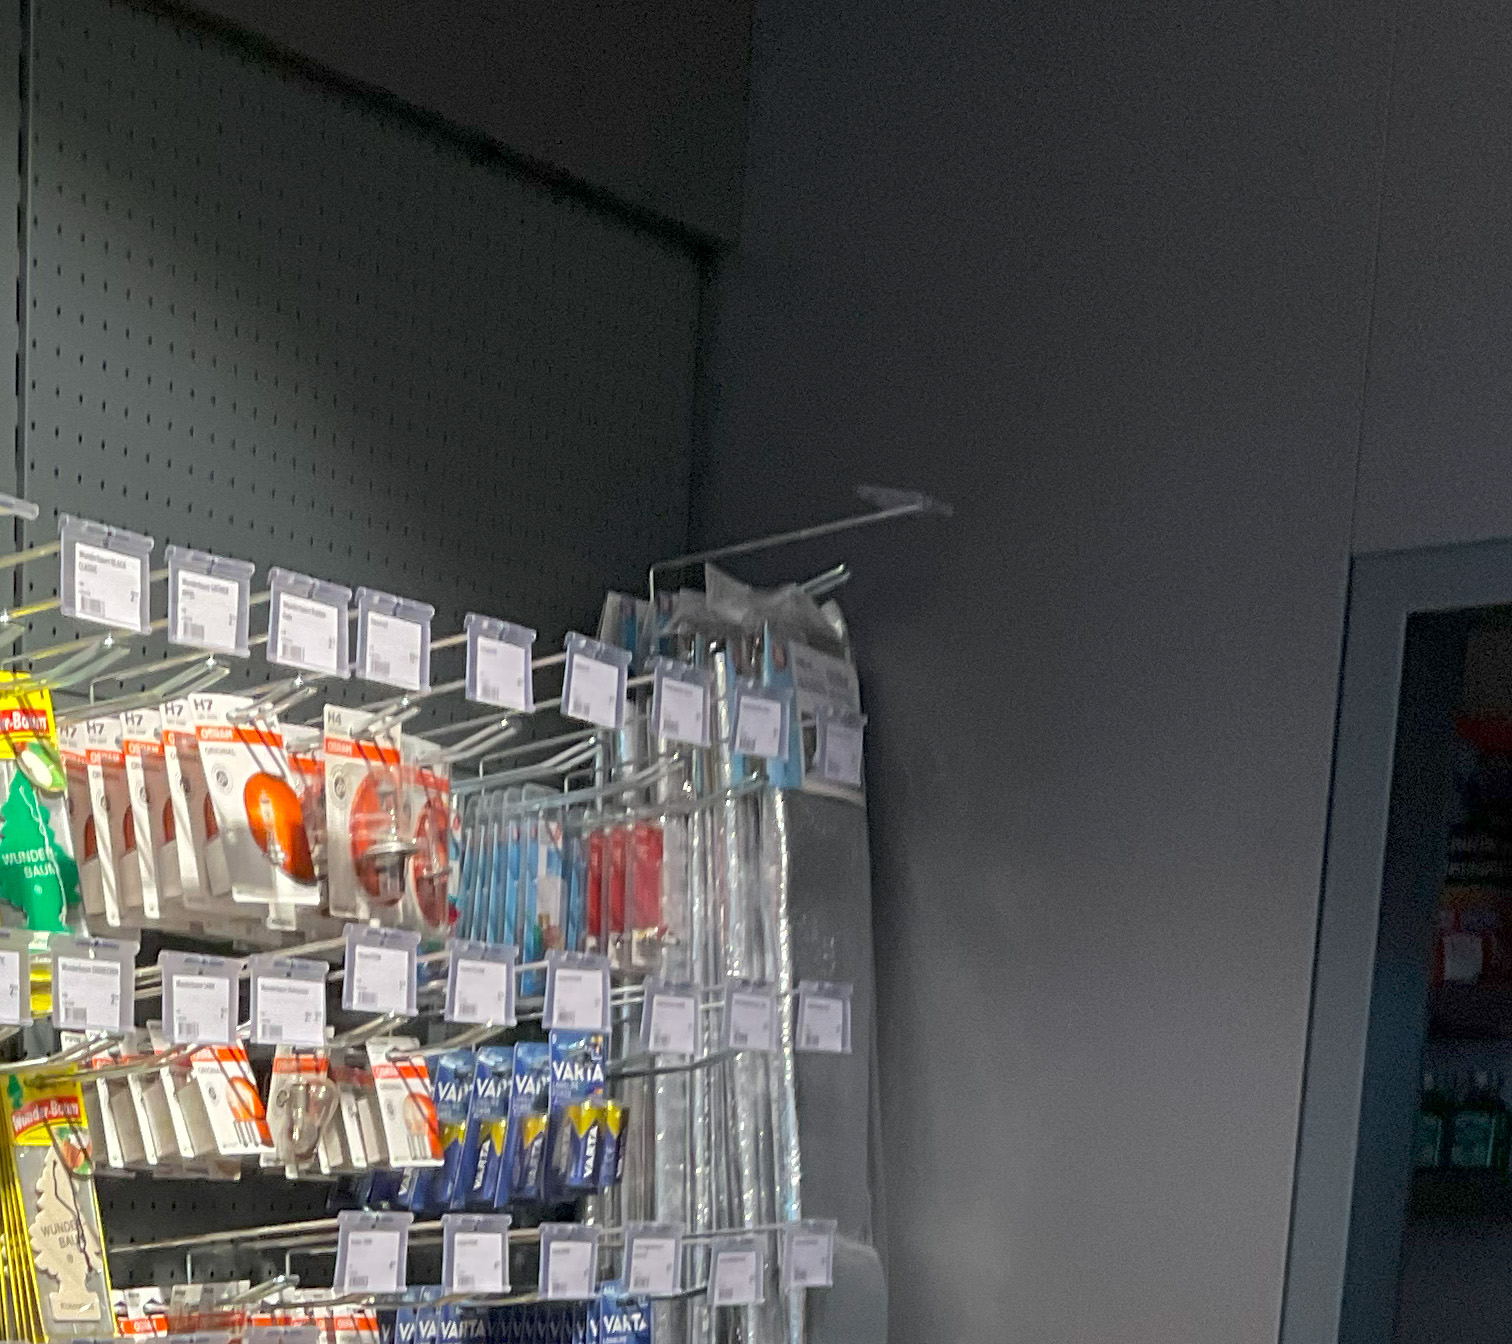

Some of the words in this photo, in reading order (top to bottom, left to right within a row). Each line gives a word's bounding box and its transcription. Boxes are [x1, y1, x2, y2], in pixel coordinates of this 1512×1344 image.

[164, 702, 184, 717] H7
[193, 698, 214, 712] H7
[326, 710, 342, 725] H4
[552, 1059, 604, 1083] VARTA
[603, 1314, 648, 1335] VARTA
